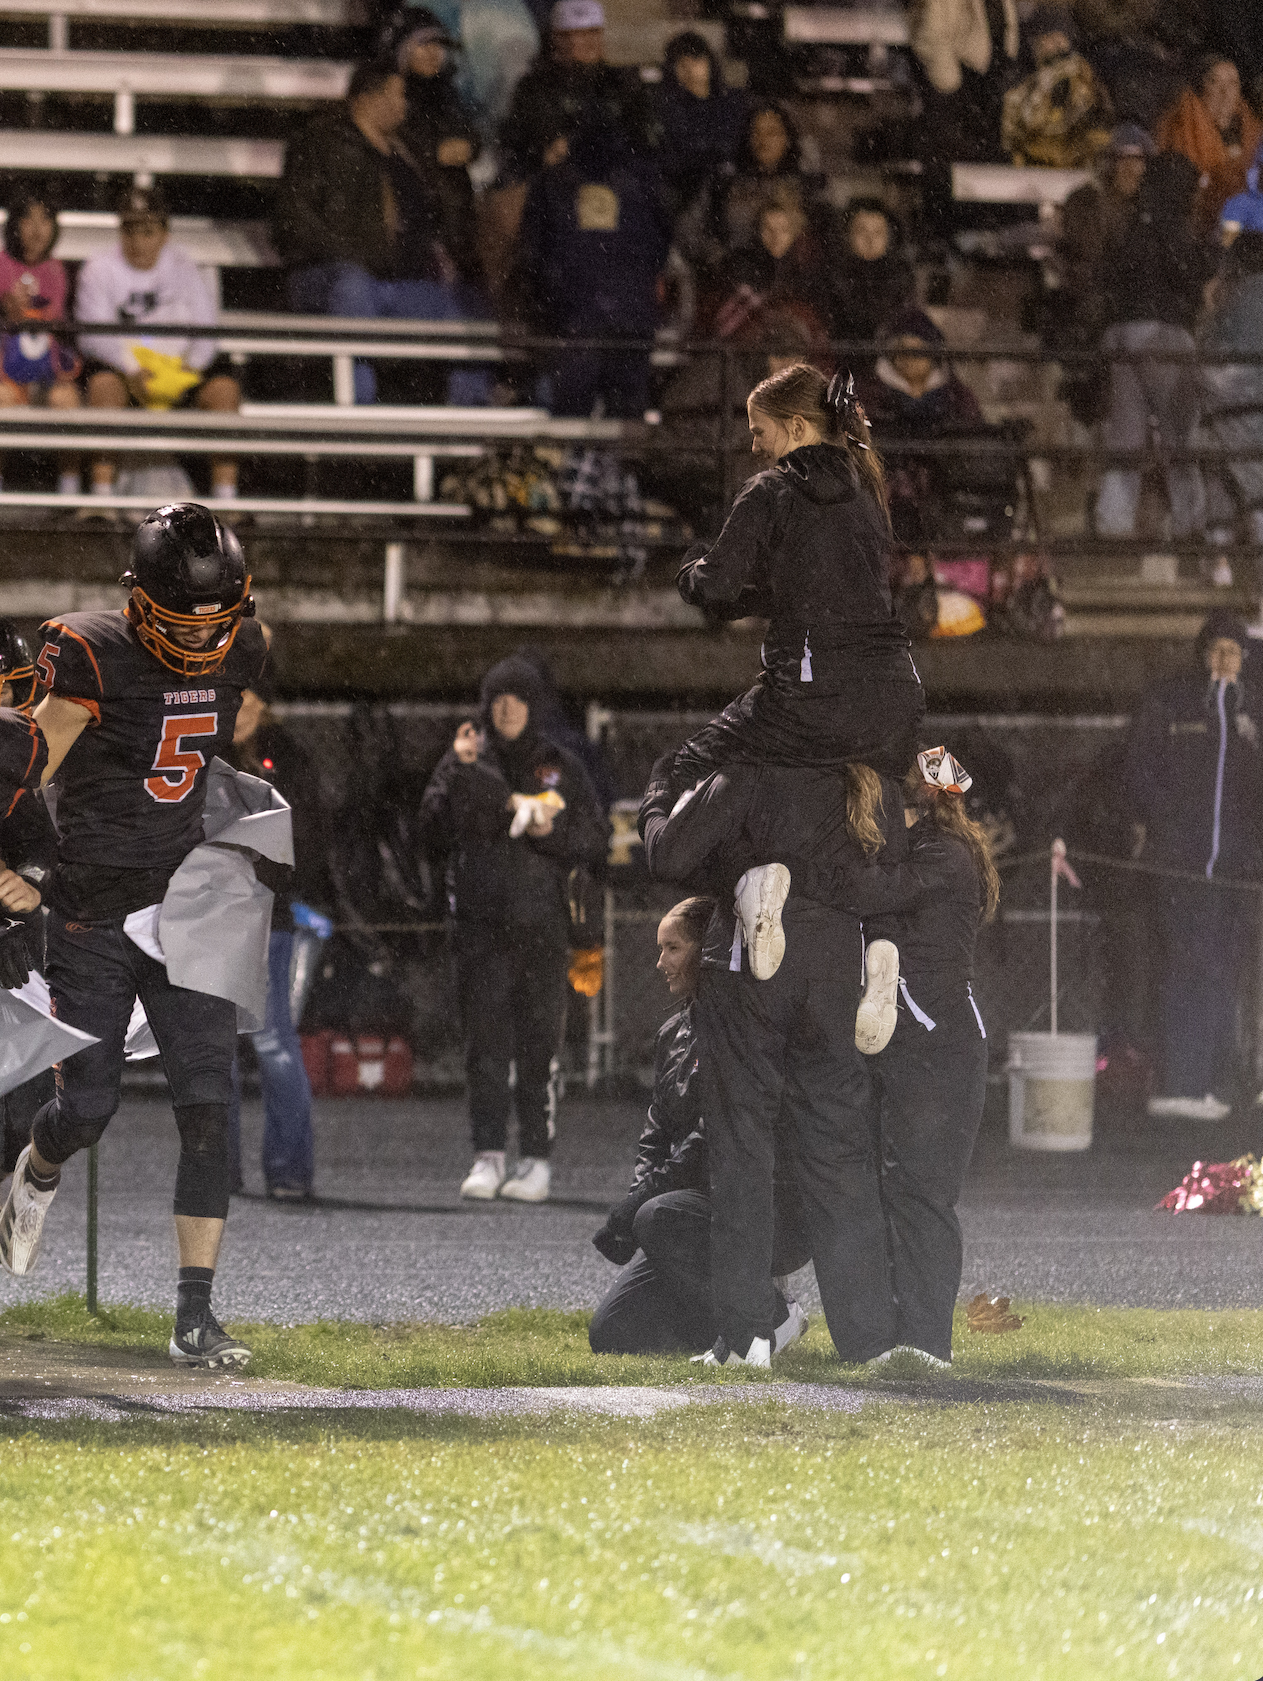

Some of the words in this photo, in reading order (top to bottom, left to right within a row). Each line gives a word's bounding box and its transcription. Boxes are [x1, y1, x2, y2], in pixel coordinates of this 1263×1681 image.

[34, 642, 61, 689] 5
[163, 689, 216, 705] TIGERS
[144, 712, 218, 803] 5
